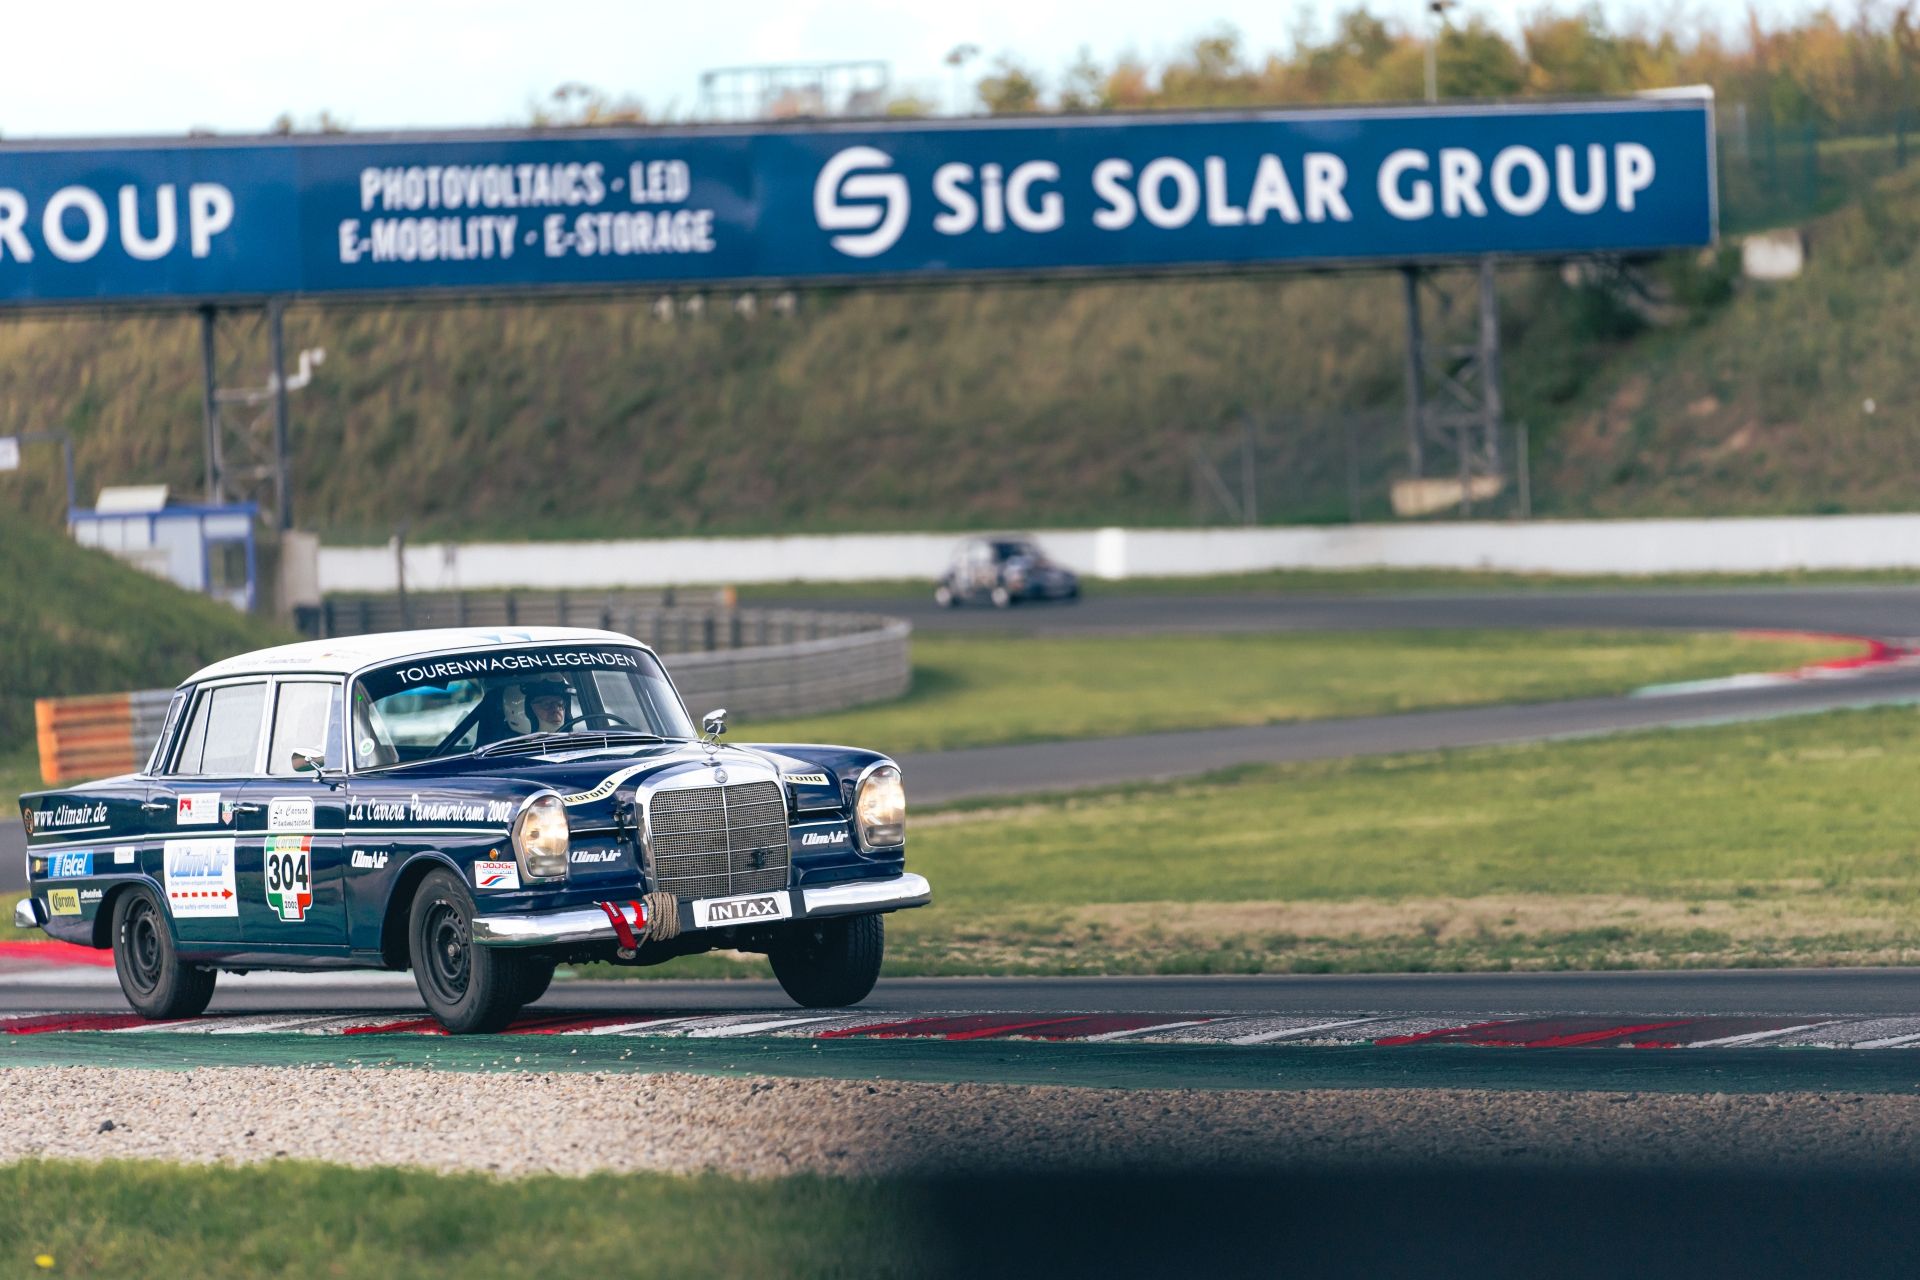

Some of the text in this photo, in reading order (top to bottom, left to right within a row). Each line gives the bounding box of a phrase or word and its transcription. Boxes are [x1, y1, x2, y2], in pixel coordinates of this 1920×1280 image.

[360, 159, 691, 212] PHOTOVOLTAICS LED
[1092, 151, 1353, 231] SOLAR
[1377, 141, 1657, 221] GROUP
[338, 209, 717, 264] E-MOBILITY E-STORAGE
[396, 651, 638, 684] TOURENWAGEN-LEGENDEN
[348, 793, 513, 823] La Carrera Panamericana 2002
[268, 853, 309, 891] 304
[284, 900, 298, 909] 2002
[711, 899, 777, 920] INTAX
